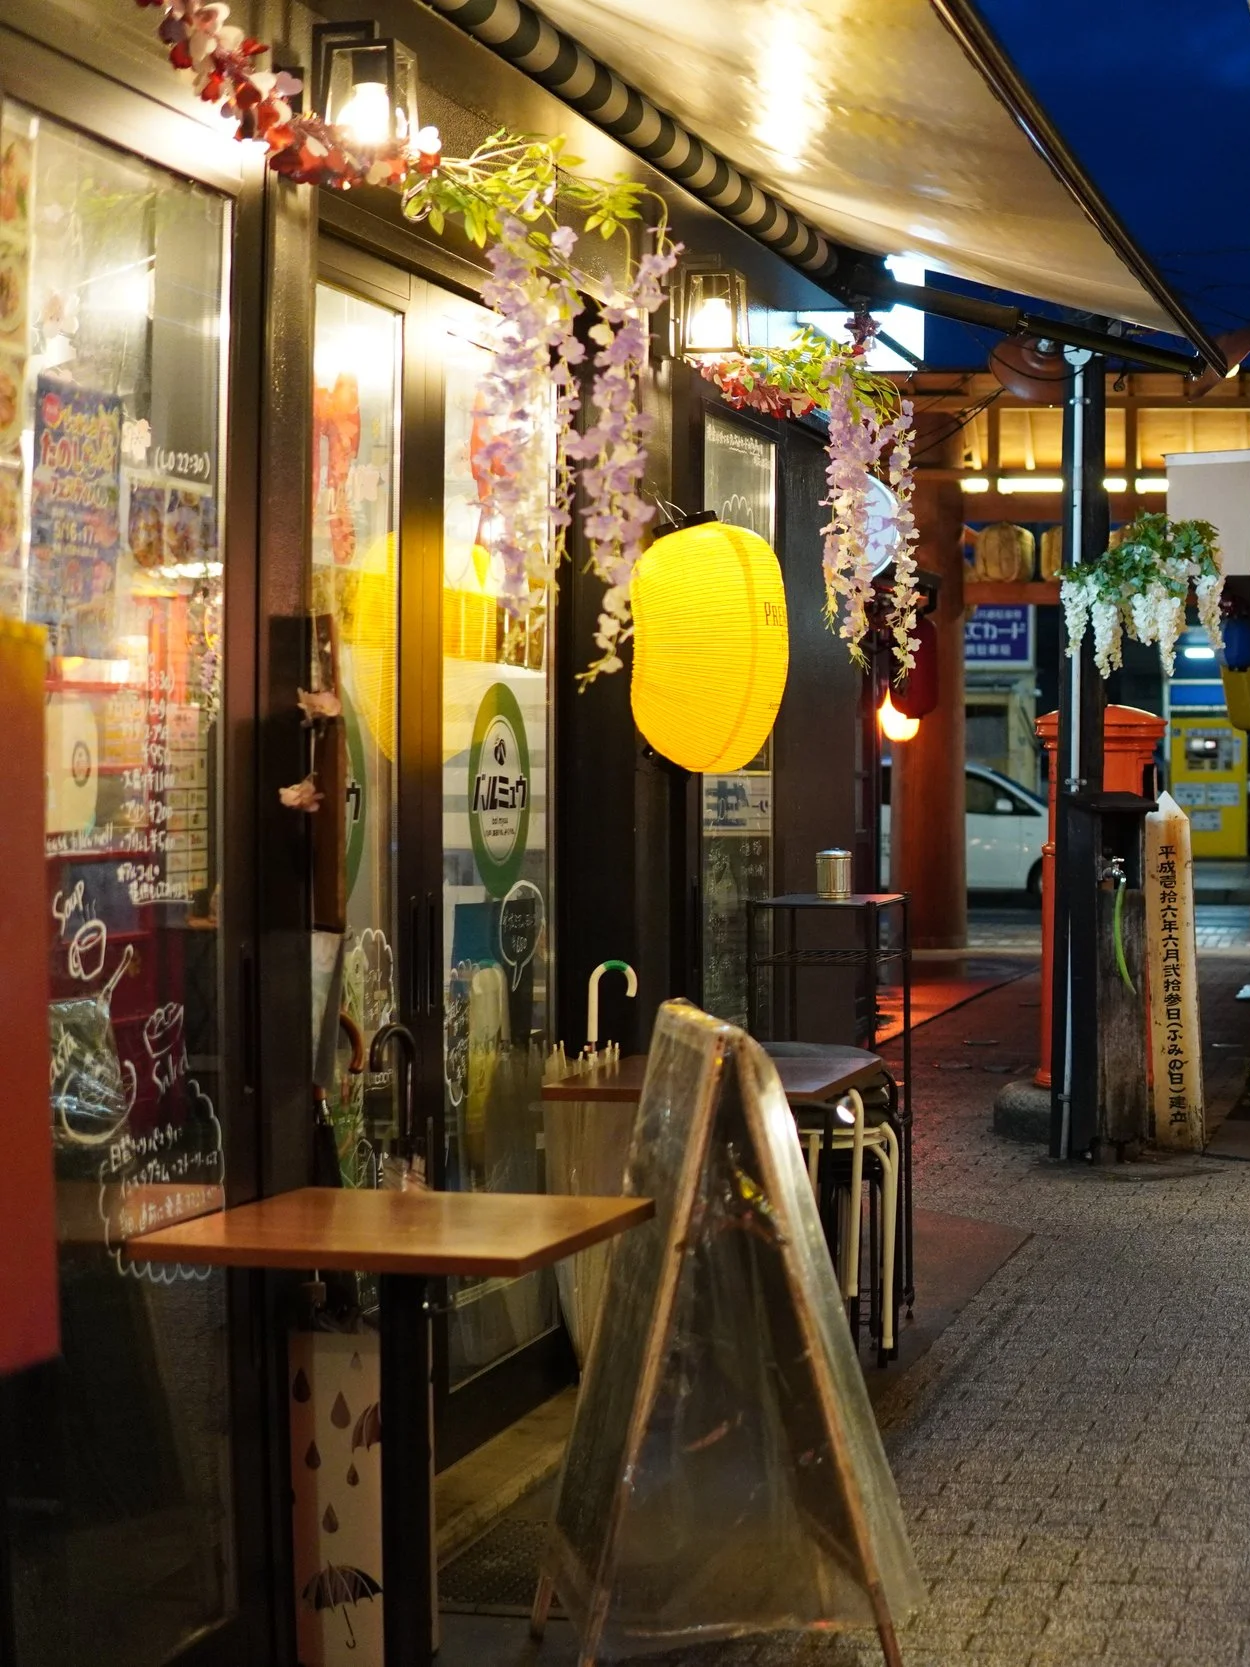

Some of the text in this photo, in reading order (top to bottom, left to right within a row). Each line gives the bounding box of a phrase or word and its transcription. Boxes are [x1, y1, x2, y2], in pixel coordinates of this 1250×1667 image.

[472, 773, 527, 812] バルミュウ
